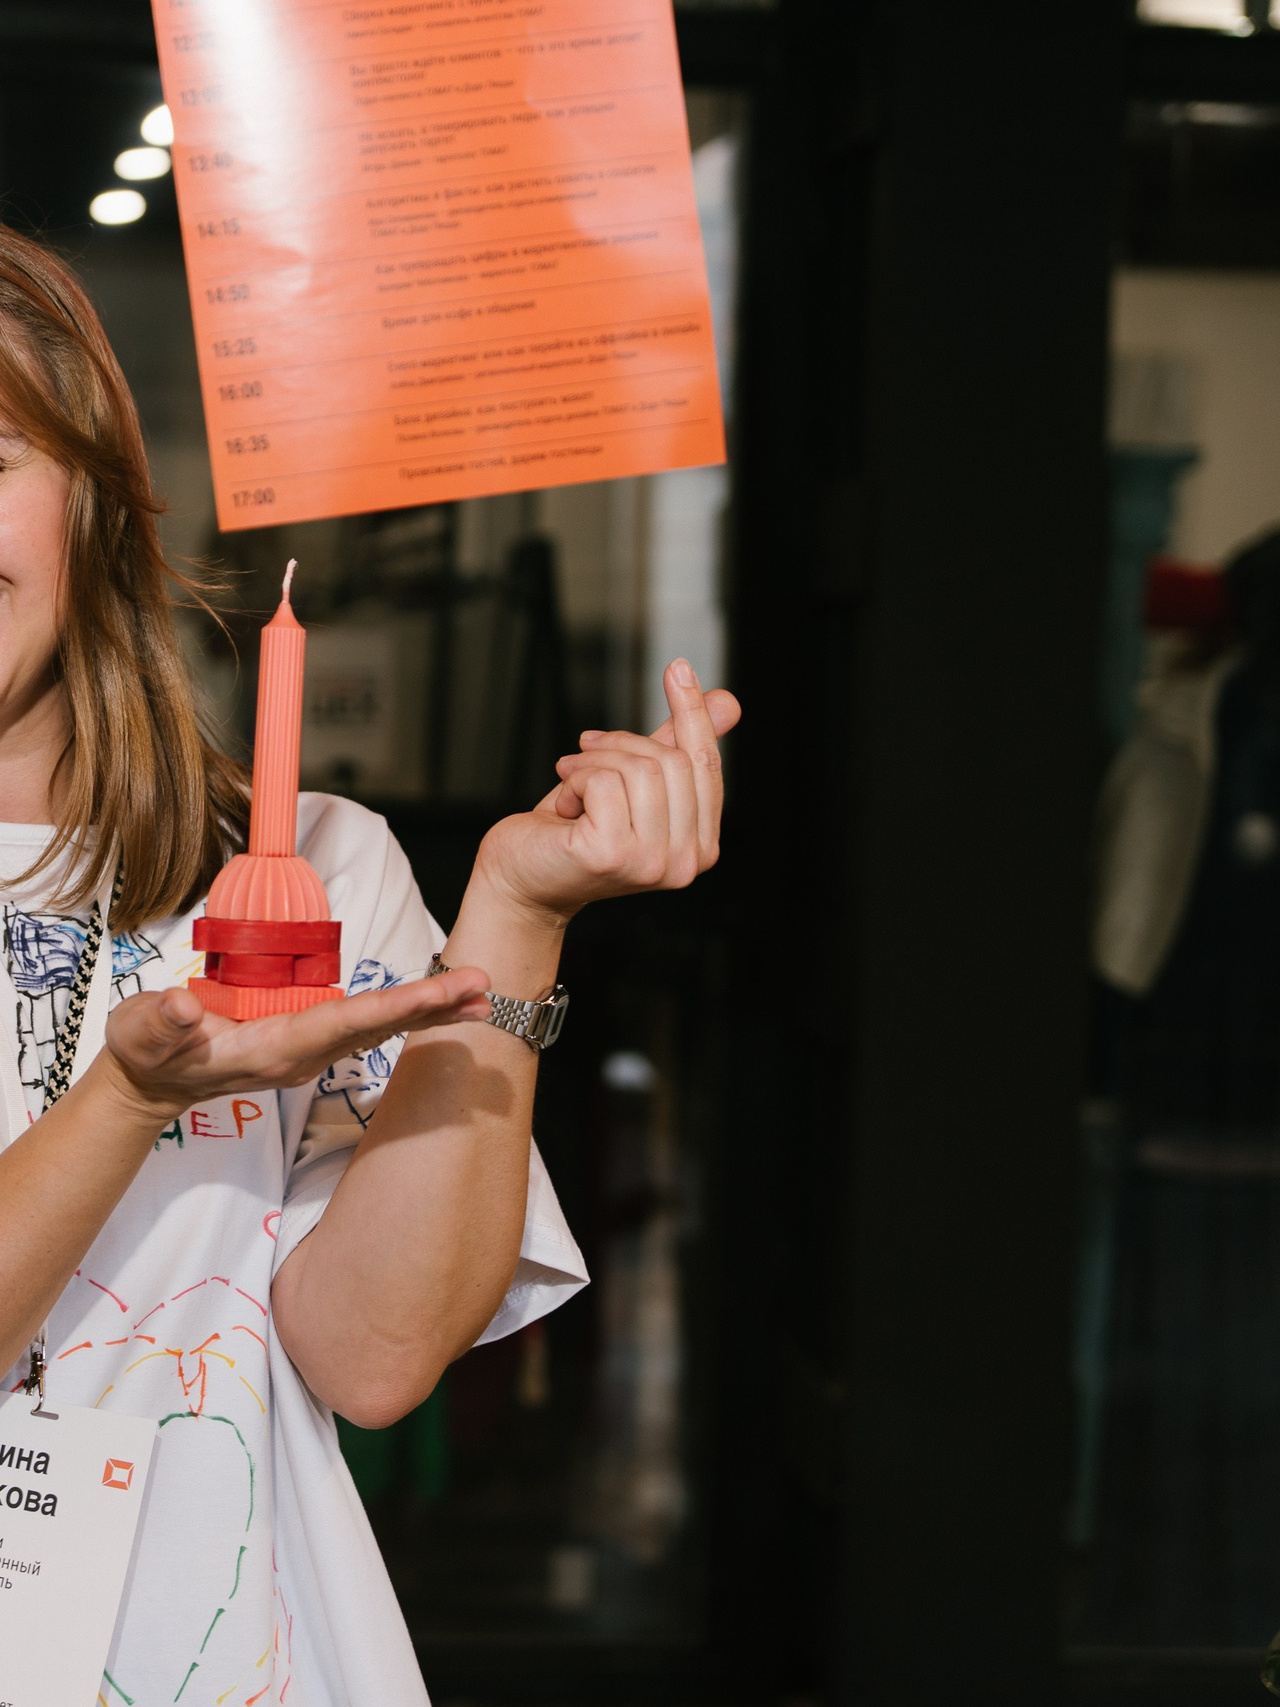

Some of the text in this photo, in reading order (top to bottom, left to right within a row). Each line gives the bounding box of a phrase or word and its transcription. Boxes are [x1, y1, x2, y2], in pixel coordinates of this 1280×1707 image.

[198, 217, 240, 239] 14:15
[206, 283, 251, 304] 14:50
[212, 336, 258, 359] 15:25
[218, 380, 264, 401] 16:00
[226, 433, 270, 455] 16:35
[232, 487, 276, 508] 17:00
